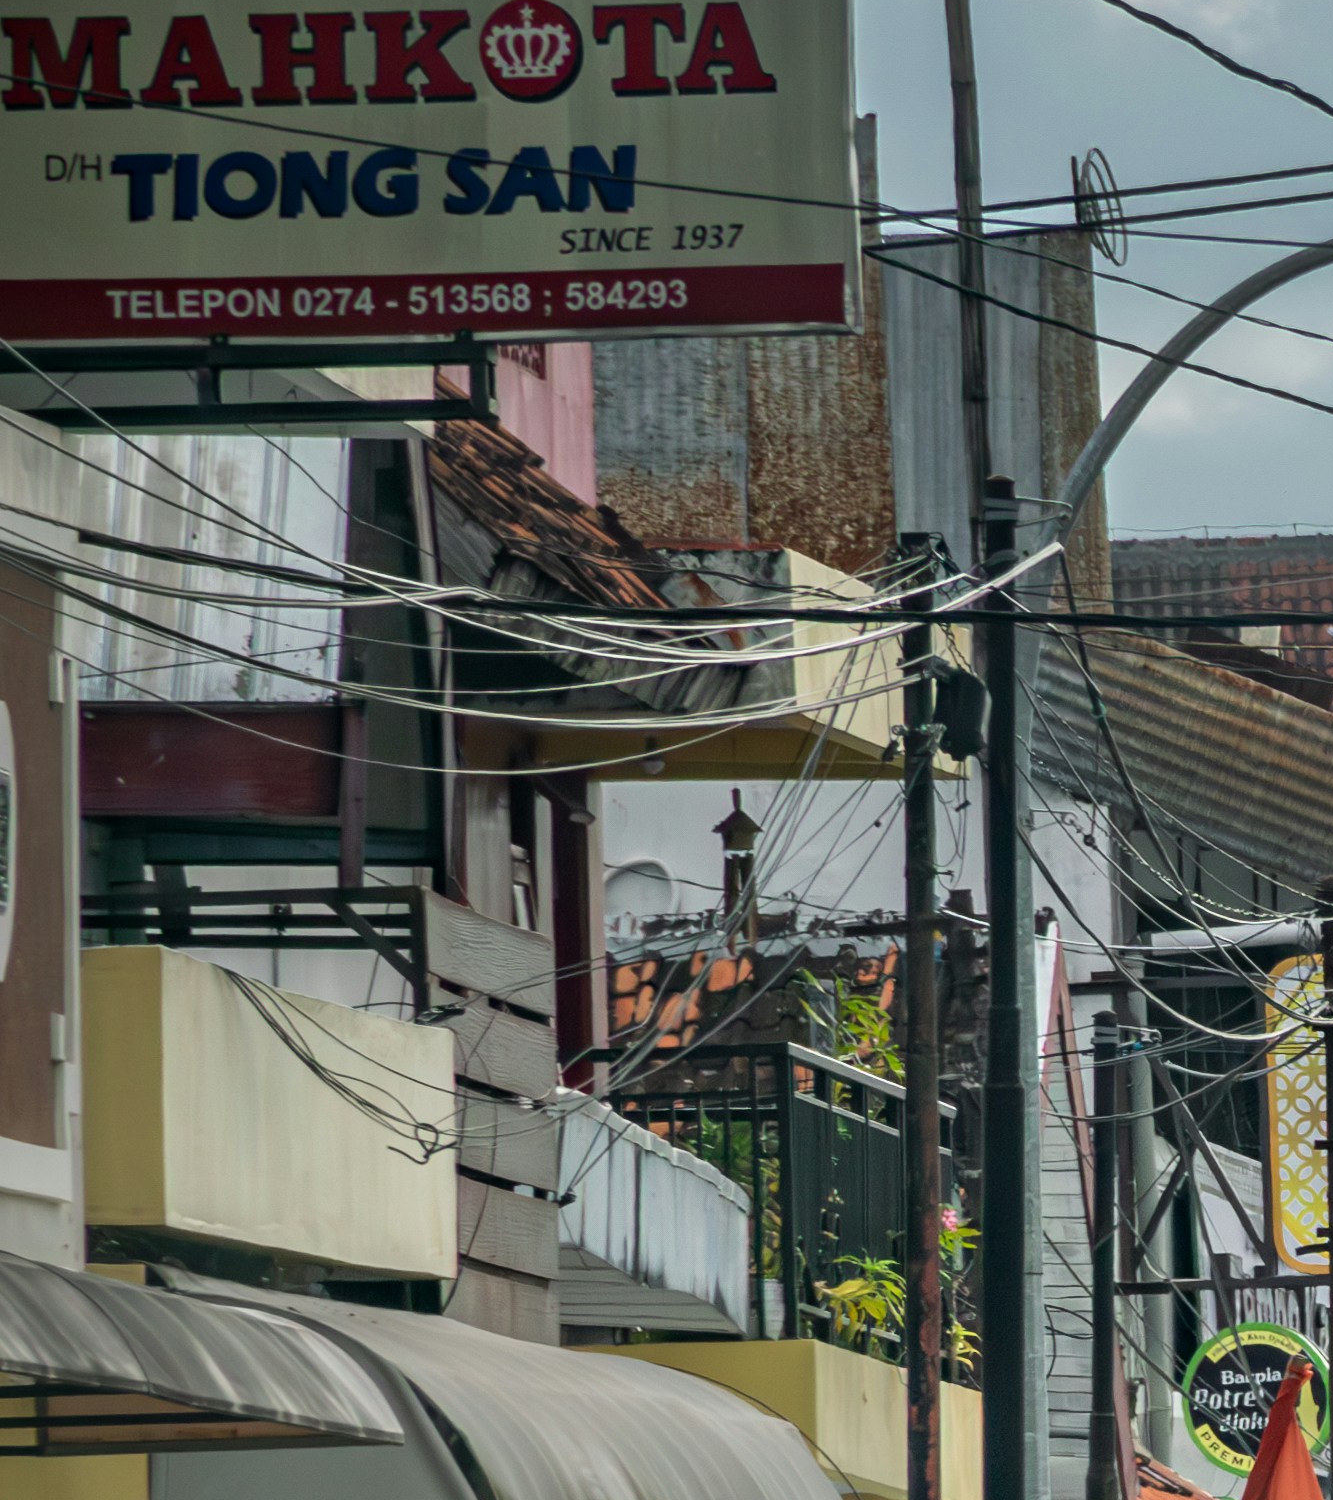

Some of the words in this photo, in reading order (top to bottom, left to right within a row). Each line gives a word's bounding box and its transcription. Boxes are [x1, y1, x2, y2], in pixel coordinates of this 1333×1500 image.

[44, 153, 103, 184] D/H
[111, 146, 421, 222] TIONG
[443, 144, 637, 217] SAN
[560, 226, 652, 254] SINCE
[671, 224, 744, 250] 1937
[107, 290, 282, 321] TELEPON
[292, 288, 375, 318] 0274
[409, 285, 531, 315] 513568
[565, 279, 688, 312] 584293
